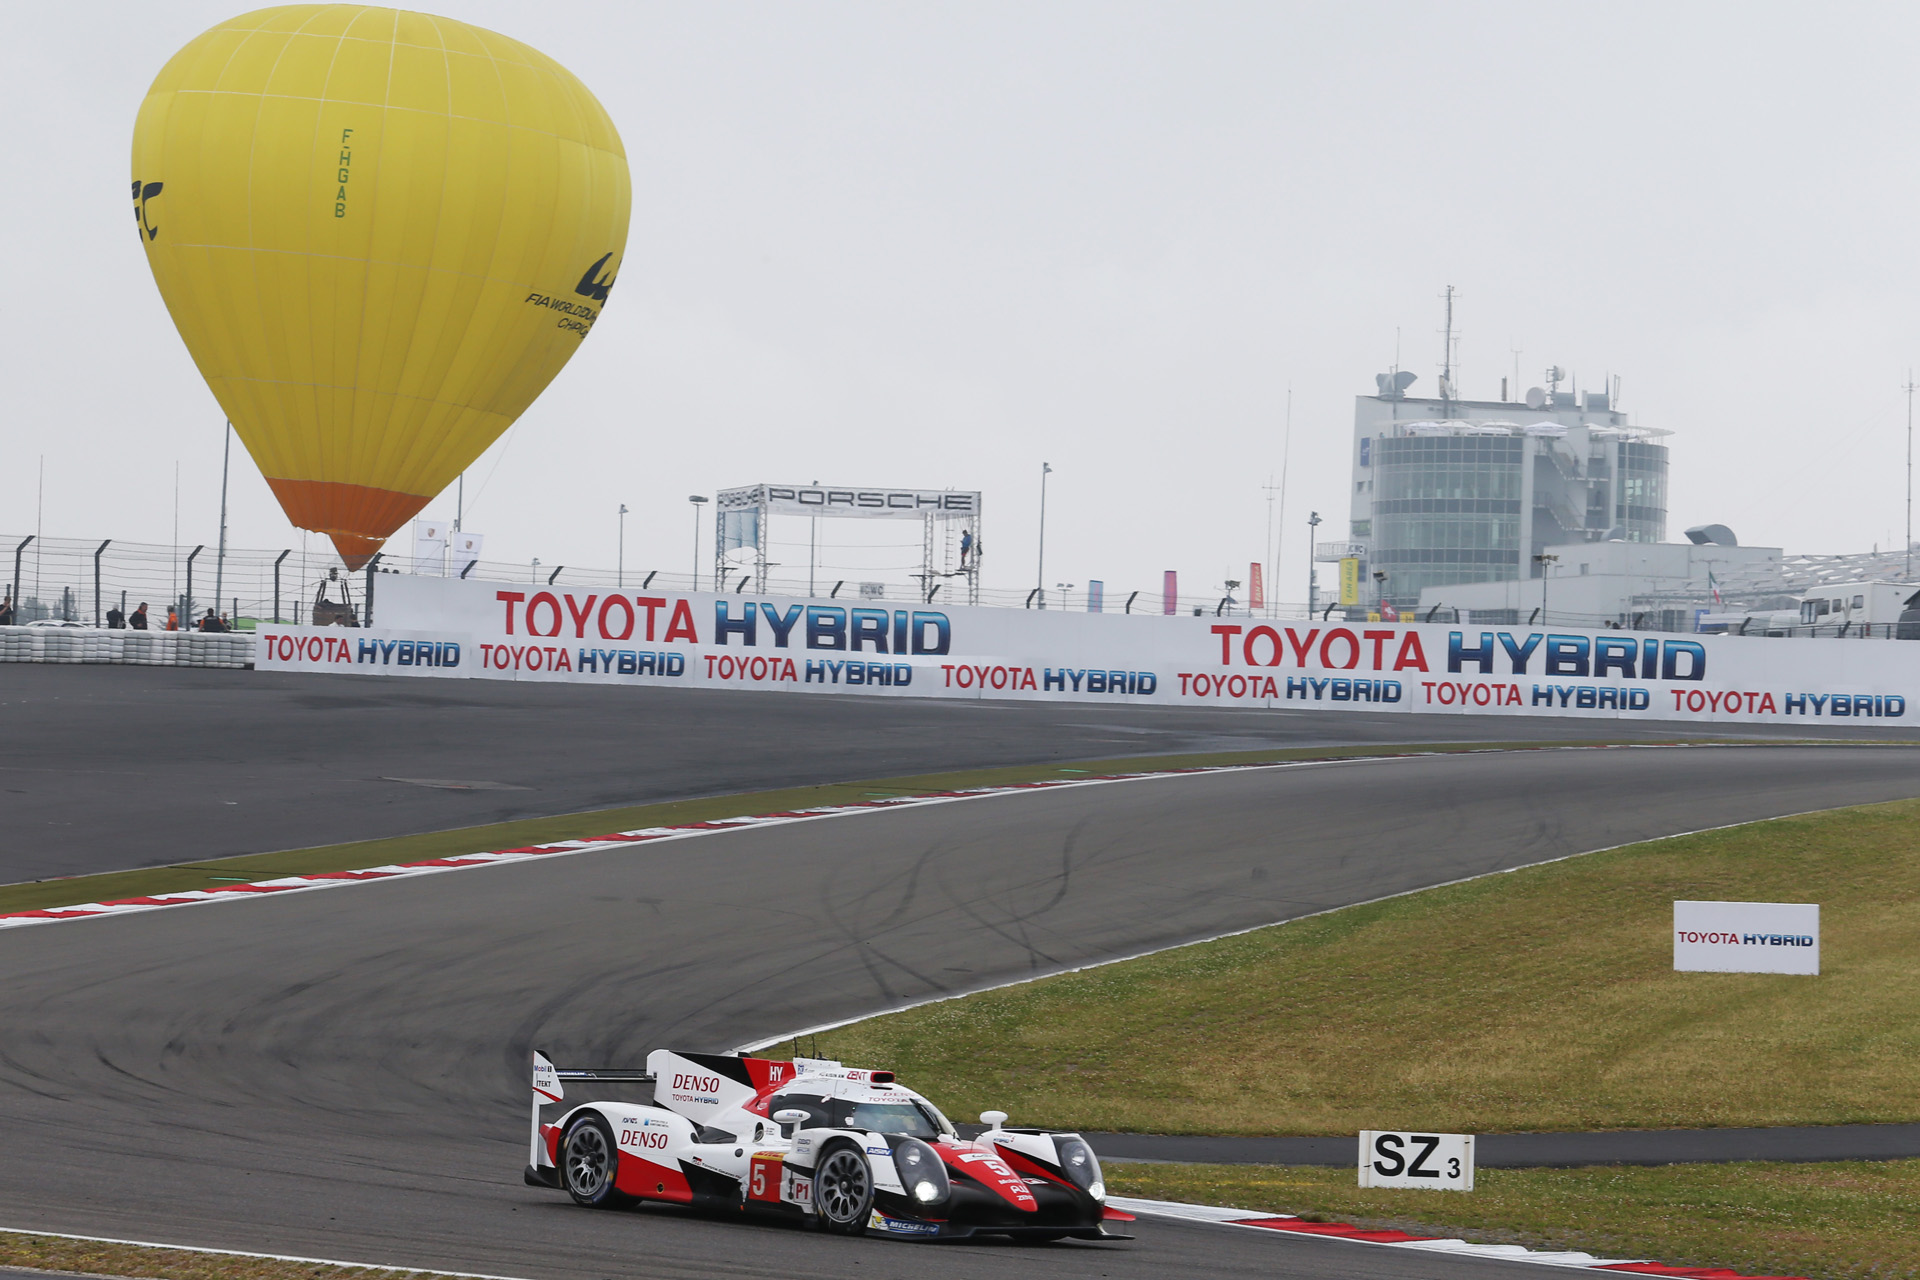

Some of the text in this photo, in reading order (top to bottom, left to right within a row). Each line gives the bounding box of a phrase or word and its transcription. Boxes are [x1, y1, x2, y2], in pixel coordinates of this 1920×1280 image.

[525, 293, 550, 308] FIA
[769, 488, 972, 510] PORSCHE
[496, 591, 951, 656] TOYOTA HYBRID
[264, 635, 461, 668] TOYOTA HYBRID
[480, 644, 685, 677] TOYOTA HYBRID
[1211, 625, 1706, 681] TOYOTA HYBRID
[704, 655, 913, 686] TOYOTA HYBRID
[941, 664, 1157, 695] TOYOTA HYBRID
[1178, 673, 1402, 703] TOYOTA HYBRID
[1421, 681, 1650, 711] TOYOTA HYBRID
[1670, 690, 1906, 718] TOYOTA HYBRID
[1678, 932, 1813, 947] TOYOTA HYBRID
[672, 1073, 720, 1093] DENSO
[770, 1066, 783, 1082] HY
[847, 1071, 868, 1080] ZENT
[672, 1094, 719, 1104] TOYOTA HYBRID
[620, 1129, 668, 1149] DENSO
[982, 1161, 1011, 1176] 5
[1373, 1134, 1461, 1179] SZ 3
[752, 1163, 766, 1196] 5
[796, 1183, 809, 1199] P1
[889, 1221, 939, 1233] MICHELIN
